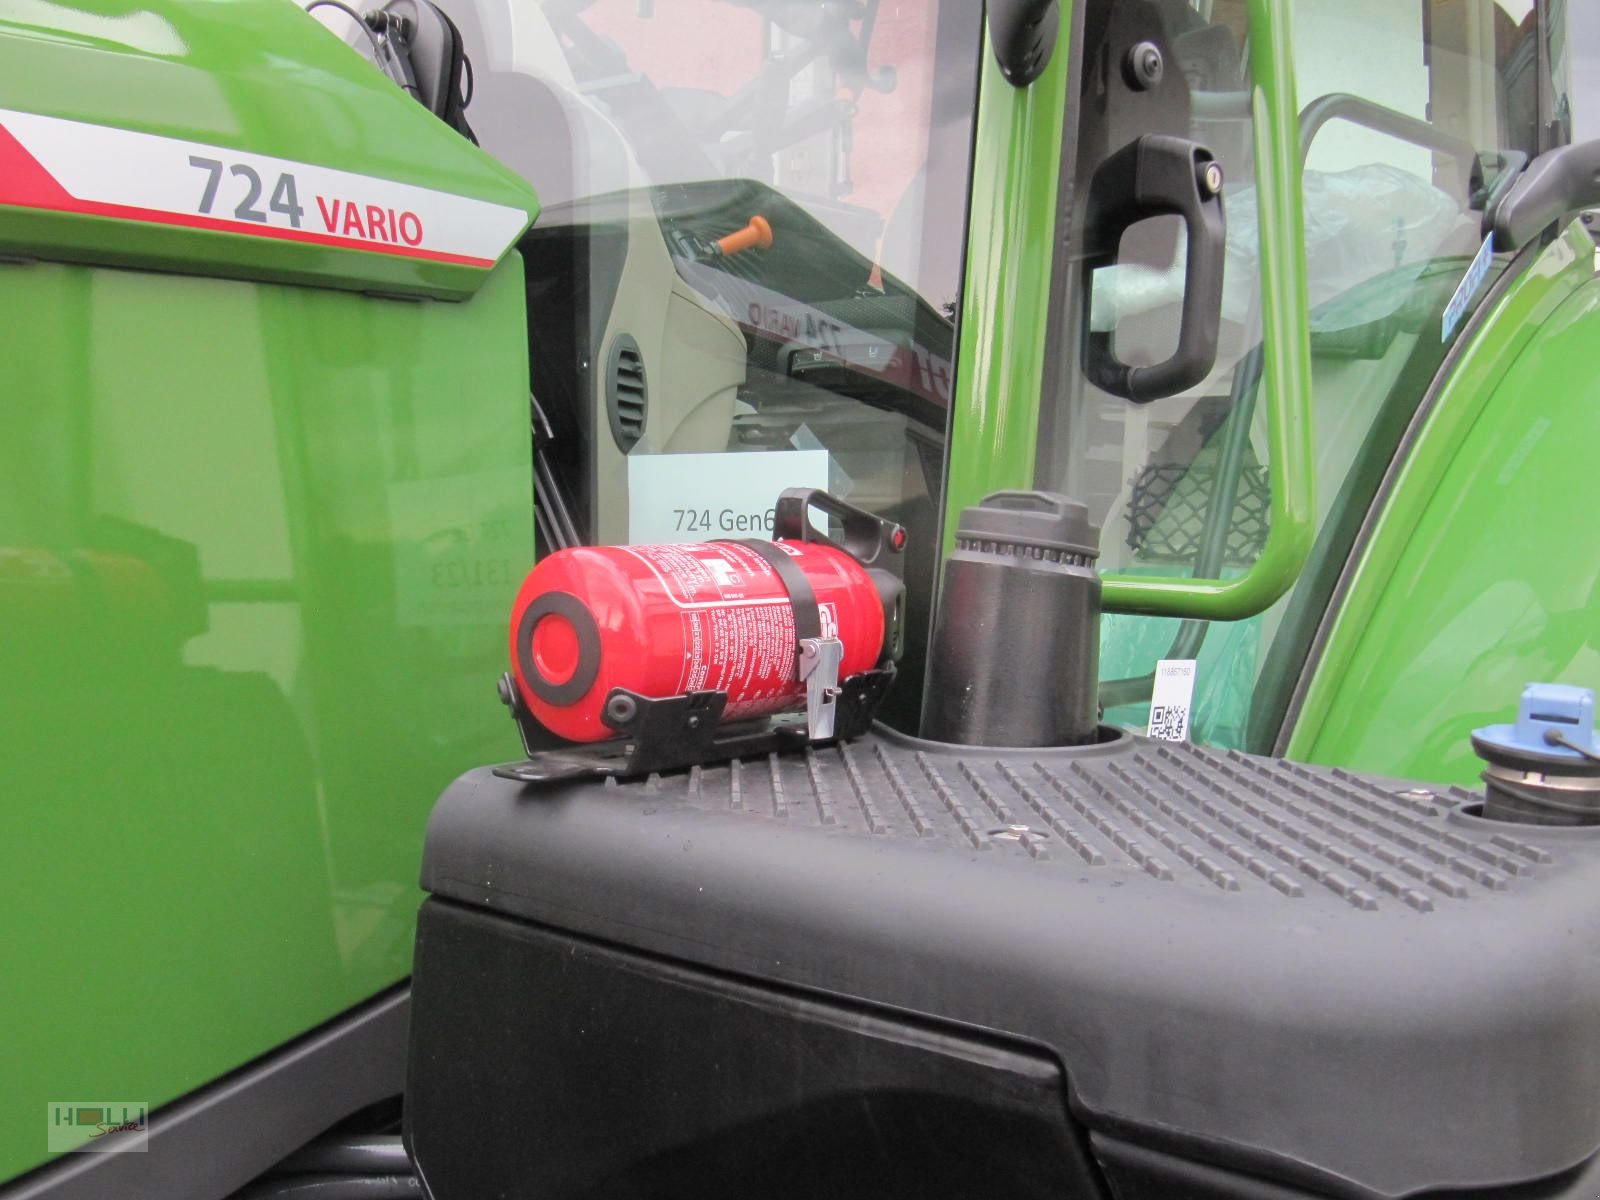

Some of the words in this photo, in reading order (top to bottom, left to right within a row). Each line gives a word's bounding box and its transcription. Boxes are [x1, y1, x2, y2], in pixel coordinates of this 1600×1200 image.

[188, 155, 304, 229] 724
[316, 195, 423, 247] VARIO
[673, 509, 712, 532] 724
